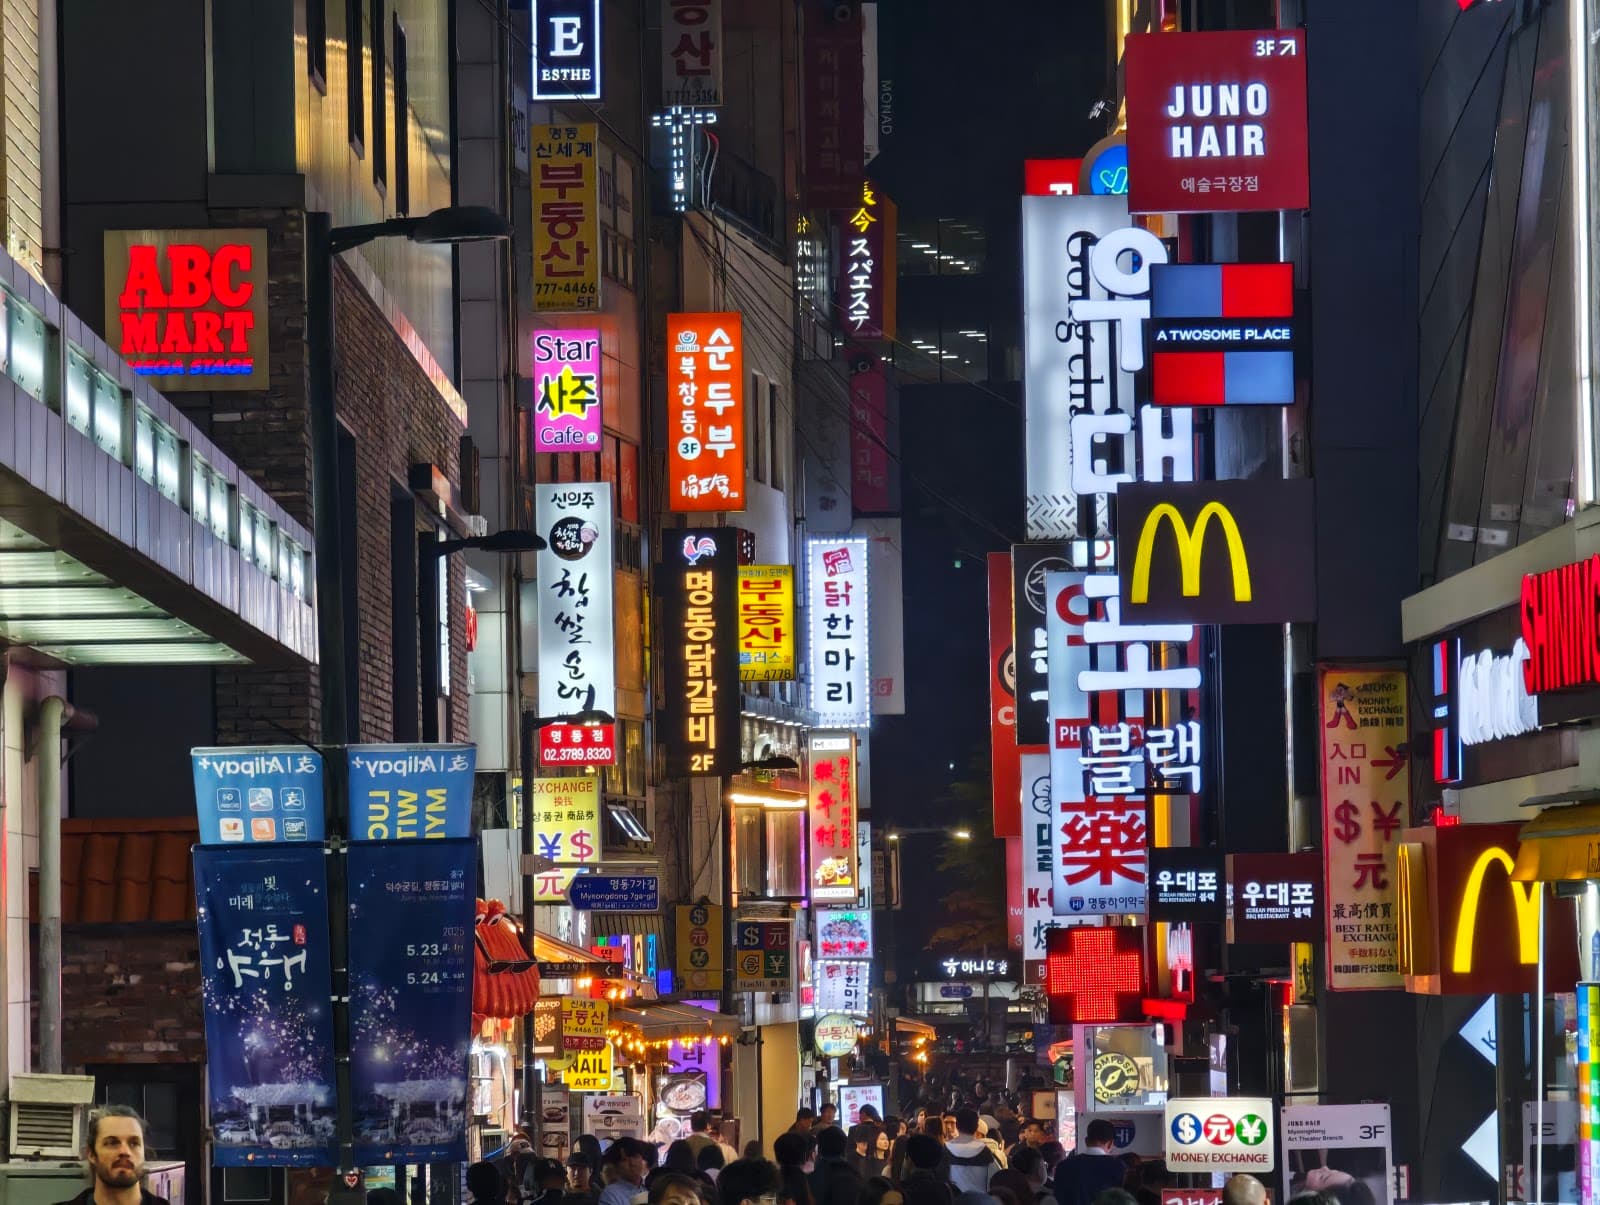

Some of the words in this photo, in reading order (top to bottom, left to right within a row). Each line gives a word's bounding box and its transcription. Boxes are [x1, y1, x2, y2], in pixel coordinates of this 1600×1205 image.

[549, 16, 584, 57] E
[1256, 40, 1275, 56] 3F
[541, 68, 592, 81] ESTHE
[1168, 84, 1268, 118] JUNO
[1171, 124, 1265, 157] HAIR
[535, 142, 593, 159] 신세계
[1181, 176, 1258, 193] 예술극장점
[539, 162, 590, 278] 부동산
[119, 244, 254, 309] ABC
[848, 237, 874, 332] スパエステ
[535, 282, 596, 296] 777-4466
[576, 296, 594, 308] 5F
[119, 310, 254, 355] MART
[1156, 331, 1167, 341] A
[1169, 329, 1241, 341] TWOSOME
[1245, 329, 1290, 340] PLACE
[535, 335, 597, 362] Star
[189, 358, 253, 376] STAGE
[537, 374, 598, 414] 사주
[678, 356, 699, 435] 북창동
[703, 327, 737, 460] 순두부
[541, 426, 584, 444] Cafe
[681, 442, 698, 455] 3F
[551, 491, 595, 510] 신의주
[740, 579, 787, 649] 부동산
[823, 580, 856, 705] 닭한마리
[684, 570, 718, 750] 명동닭갈비
[1358, 706, 1404, 714] EXCHANGE
[551, 729, 604, 744] 명동점
[1060, 724, 1145, 742] PHCY
[543, 748, 612, 762] 02.3789.8320
[1078, 720, 1201, 793] 블랙
[1330, 743, 1366, 760] 入口
[691, 754, 714, 772] 2F
[1338, 766, 1361, 785] IN
[533, 781, 594, 794] EXCHANGE
[1334, 800, 1361, 844] $
[1371, 800, 1402, 842] ¥
[538, 832, 562, 861] ¥
[570, 829, 594, 862] $
[1353, 853, 1389, 890] 元
[610, 879, 656, 891] 명동7가길
[1156, 870, 1218, 892] 우대포
[229, 894, 254, 910] 미래
[580, 892, 628, 901] Myeongdong
[1242, 882, 1315, 906] 우대포
[237, 924, 290, 950] 정동
[442, 926, 465, 938] 2025
[1335, 924, 1361, 933] BEST
[1365, 924, 1391, 933] RATE
[1343, 933, 1398, 943] EXCHANG
[562, 1010, 605, 1026] 부동산
[818, 1025, 857, 1041] 부동산
[567, 1058, 608, 1074] NAIL
[575, 1078, 598, 1087] ART
[1178, 1115, 1196, 1143] $
[1208, 1117, 1231, 1142] 元
[1242, 1118, 1261, 1144] ¥
[1359, 1125, 1385, 1139] 3F
[1171, 1152, 1209, 1163] MONEY
[1211, 1152, 1269, 1163] EXCHANGE
